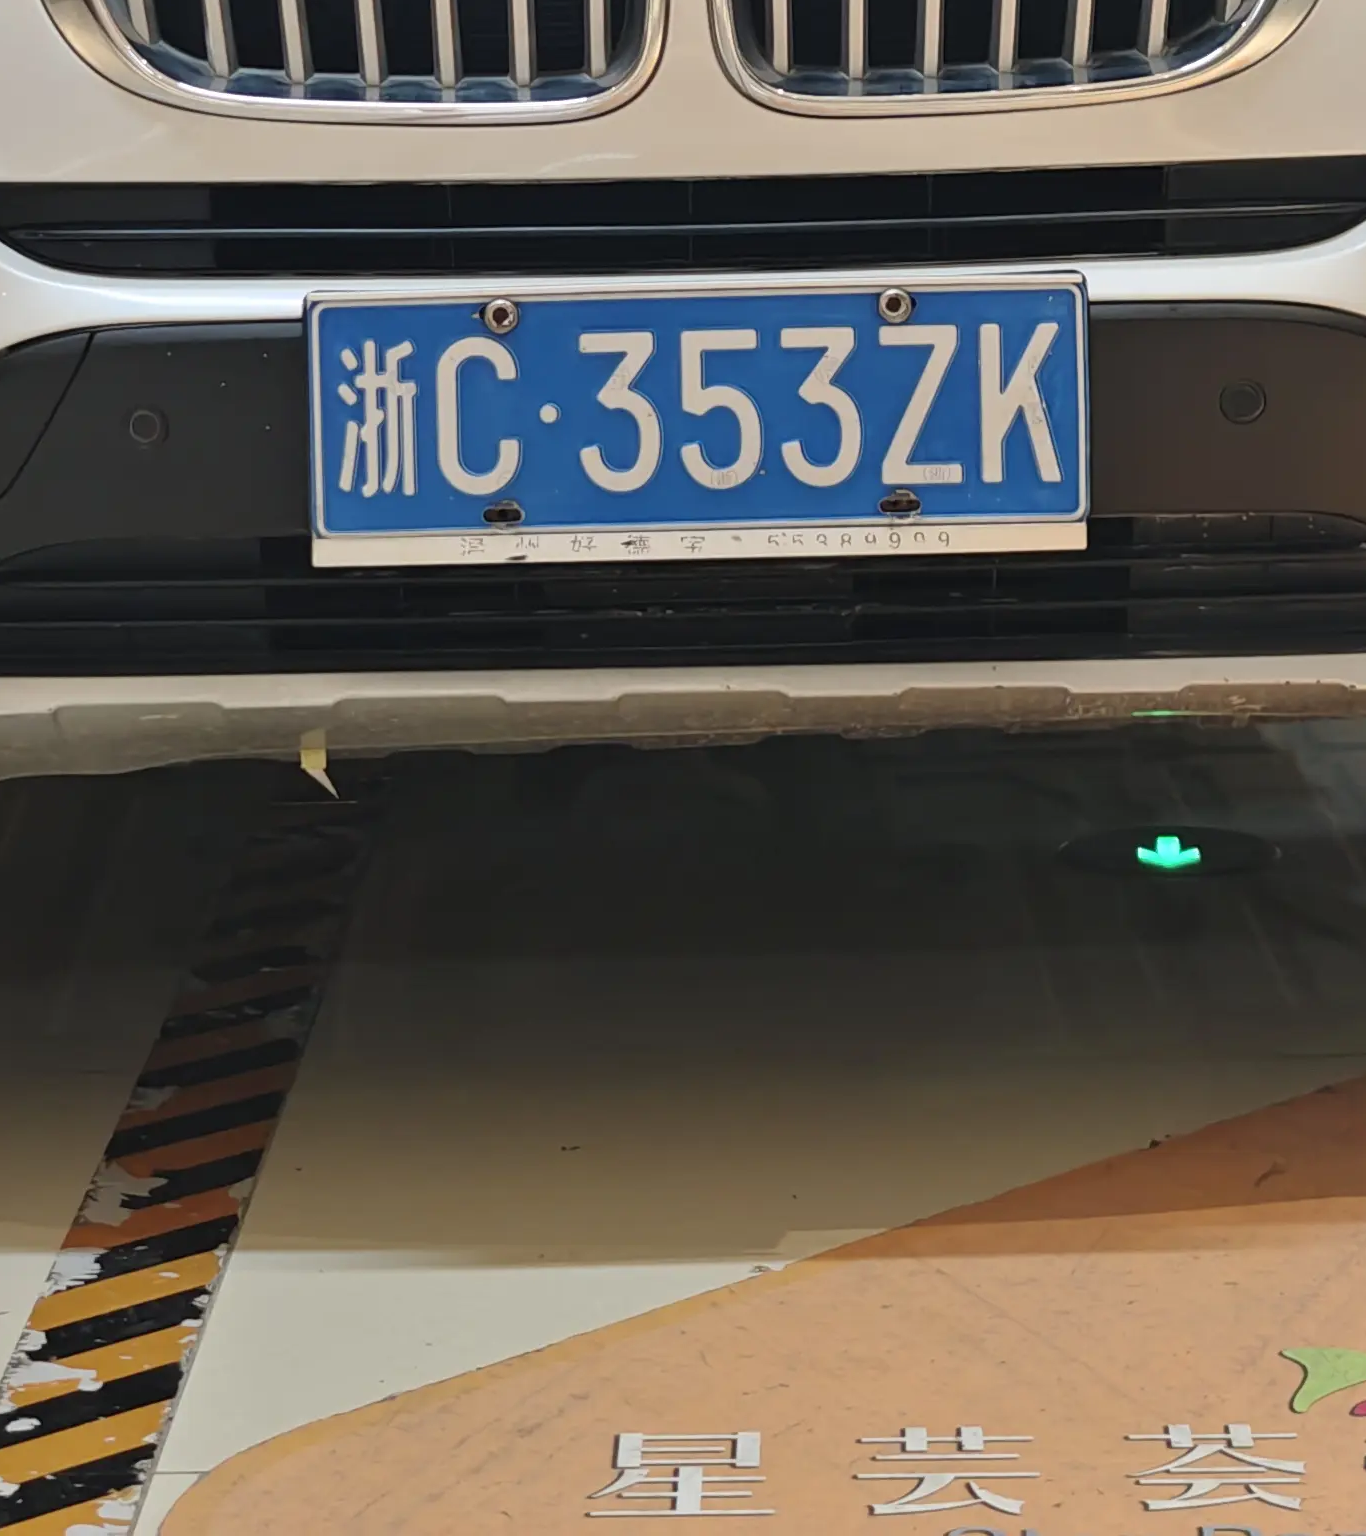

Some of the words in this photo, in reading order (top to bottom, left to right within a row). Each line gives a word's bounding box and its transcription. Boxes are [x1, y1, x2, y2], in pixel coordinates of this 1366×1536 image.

[337, 321, 1064, 498] 浙C·353ZK
[584, 1422, 1306, 1517] 星芸荟
